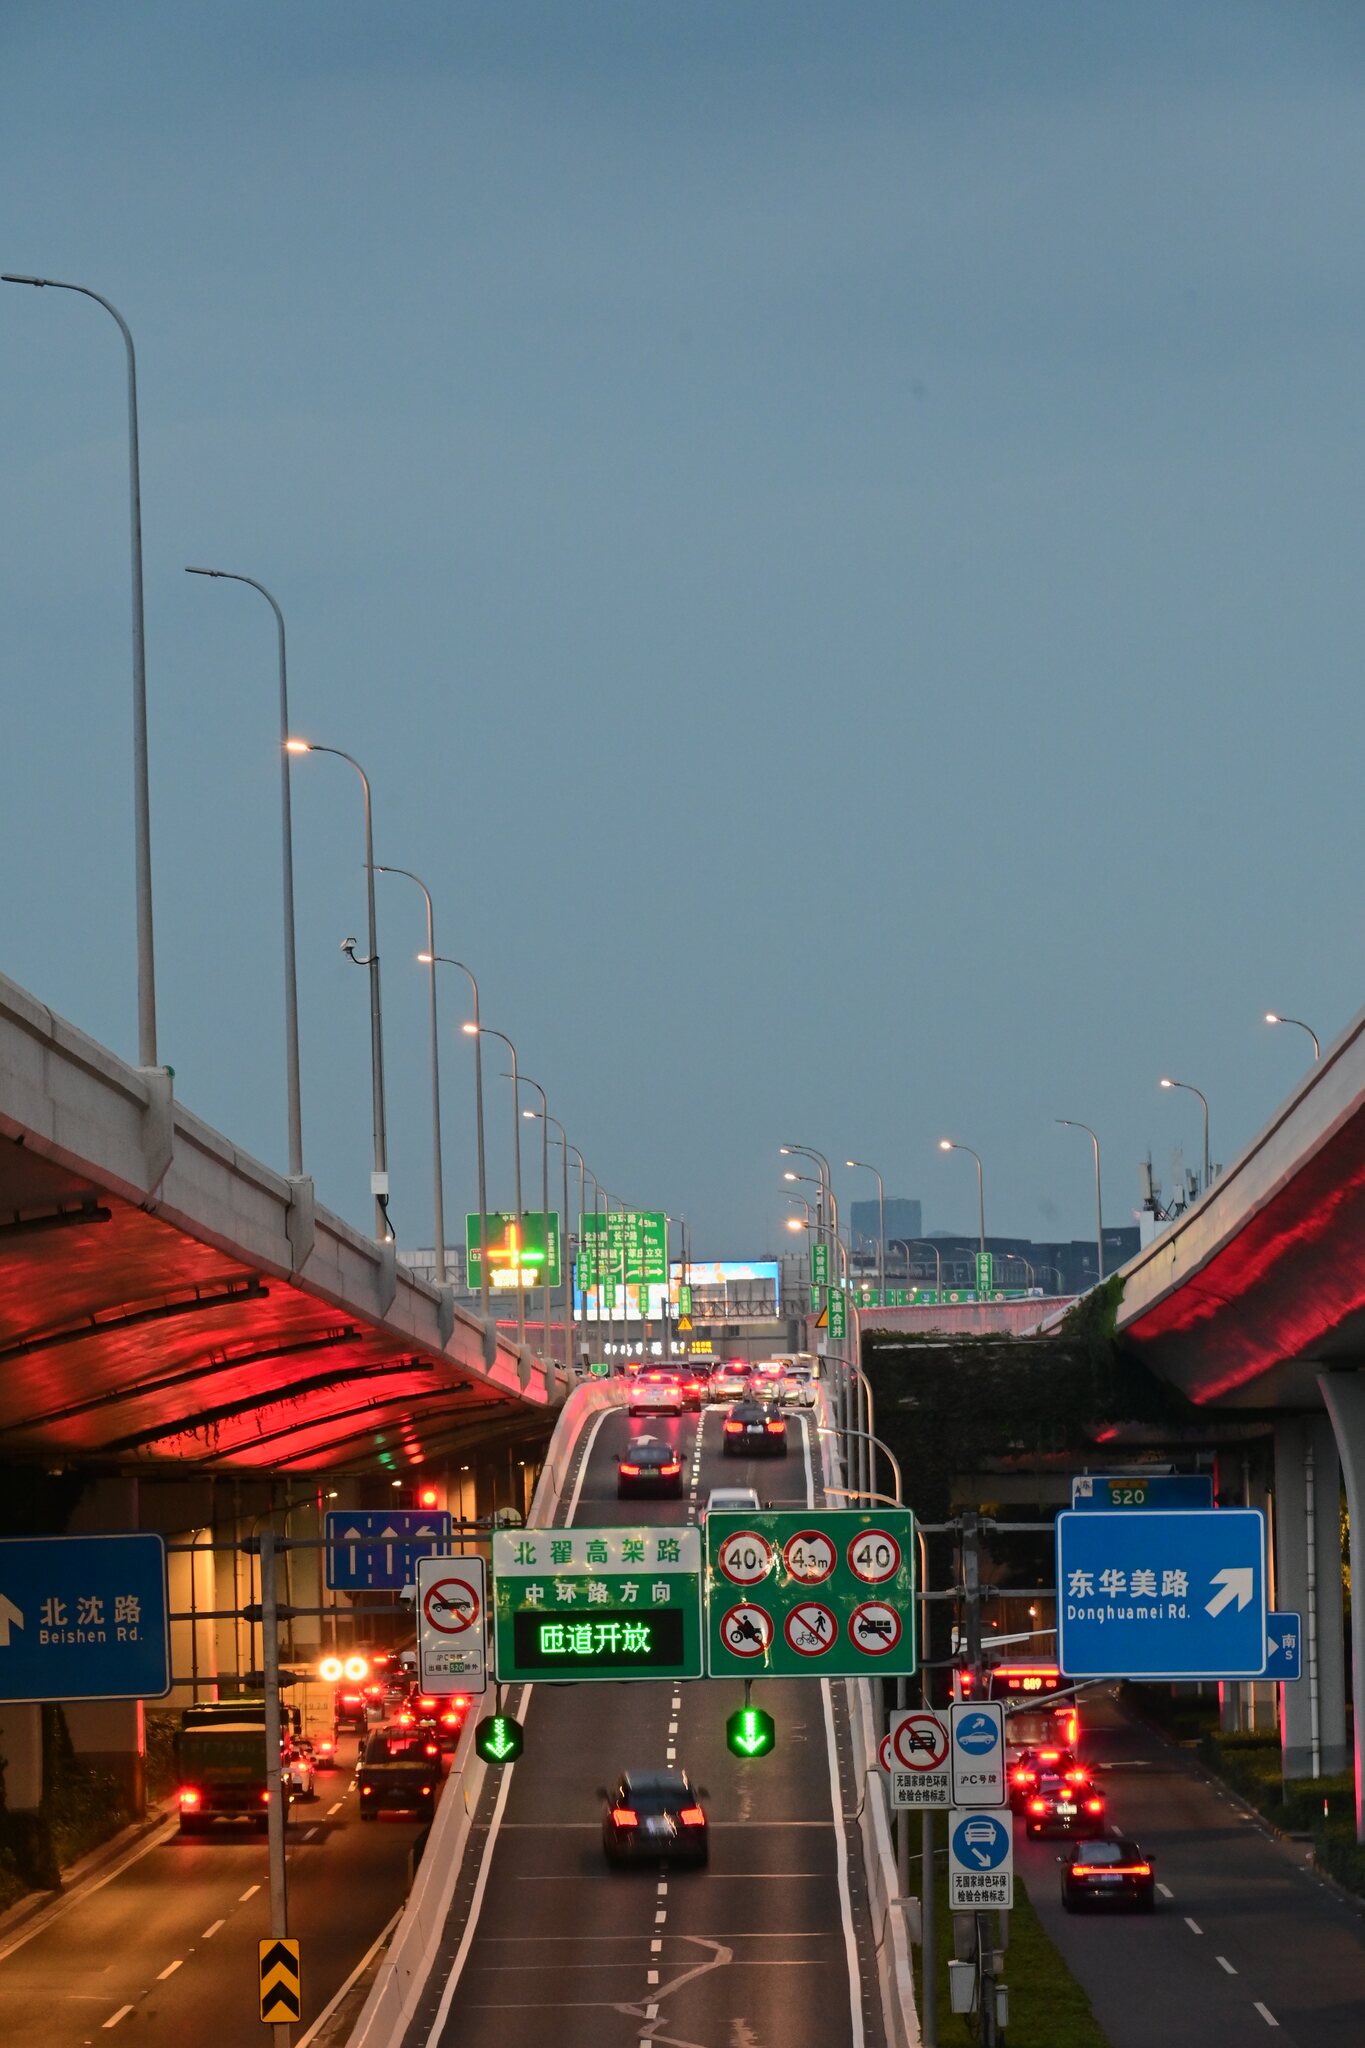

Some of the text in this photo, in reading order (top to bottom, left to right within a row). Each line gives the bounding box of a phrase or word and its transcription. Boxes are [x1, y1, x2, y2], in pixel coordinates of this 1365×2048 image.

[816, 1246, 825, 1284] 交替通行
[832, 1290, 843, 1337] 车道合并
[1111, 1489, 1145, 1505] S20
[514, 1538, 681, 1566] 北翟高架路
[790, 1547, 828, 1569] 4.3m
[857, 1544, 891, 1569] 40
[525, 1581, 670, 1605] 中环路方向
[1067, 1568, 1189, 1599] 东华美路
[40, 1594, 142, 1627] 北沈路
[1067, 1603, 1191, 1624] Donghuamei Rd.
[40, 1627, 143, 1645] Beishen Rd.
[540, 1622, 651, 1654] 匝道开放
[1282, 1633, 1296, 1649] 南
[1285, 1650, 1293, 1660] S
[897, 1775, 949, 1787] 无国家绿色环保
[960, 1774, 998, 1785] 沪C号牌
[898, 1789, 946, 1802] 检验合格标志
[955, 1875, 1008, 1888] 无国家绿色环保
[957, 1890, 1006, 1902] 检验合格标志
